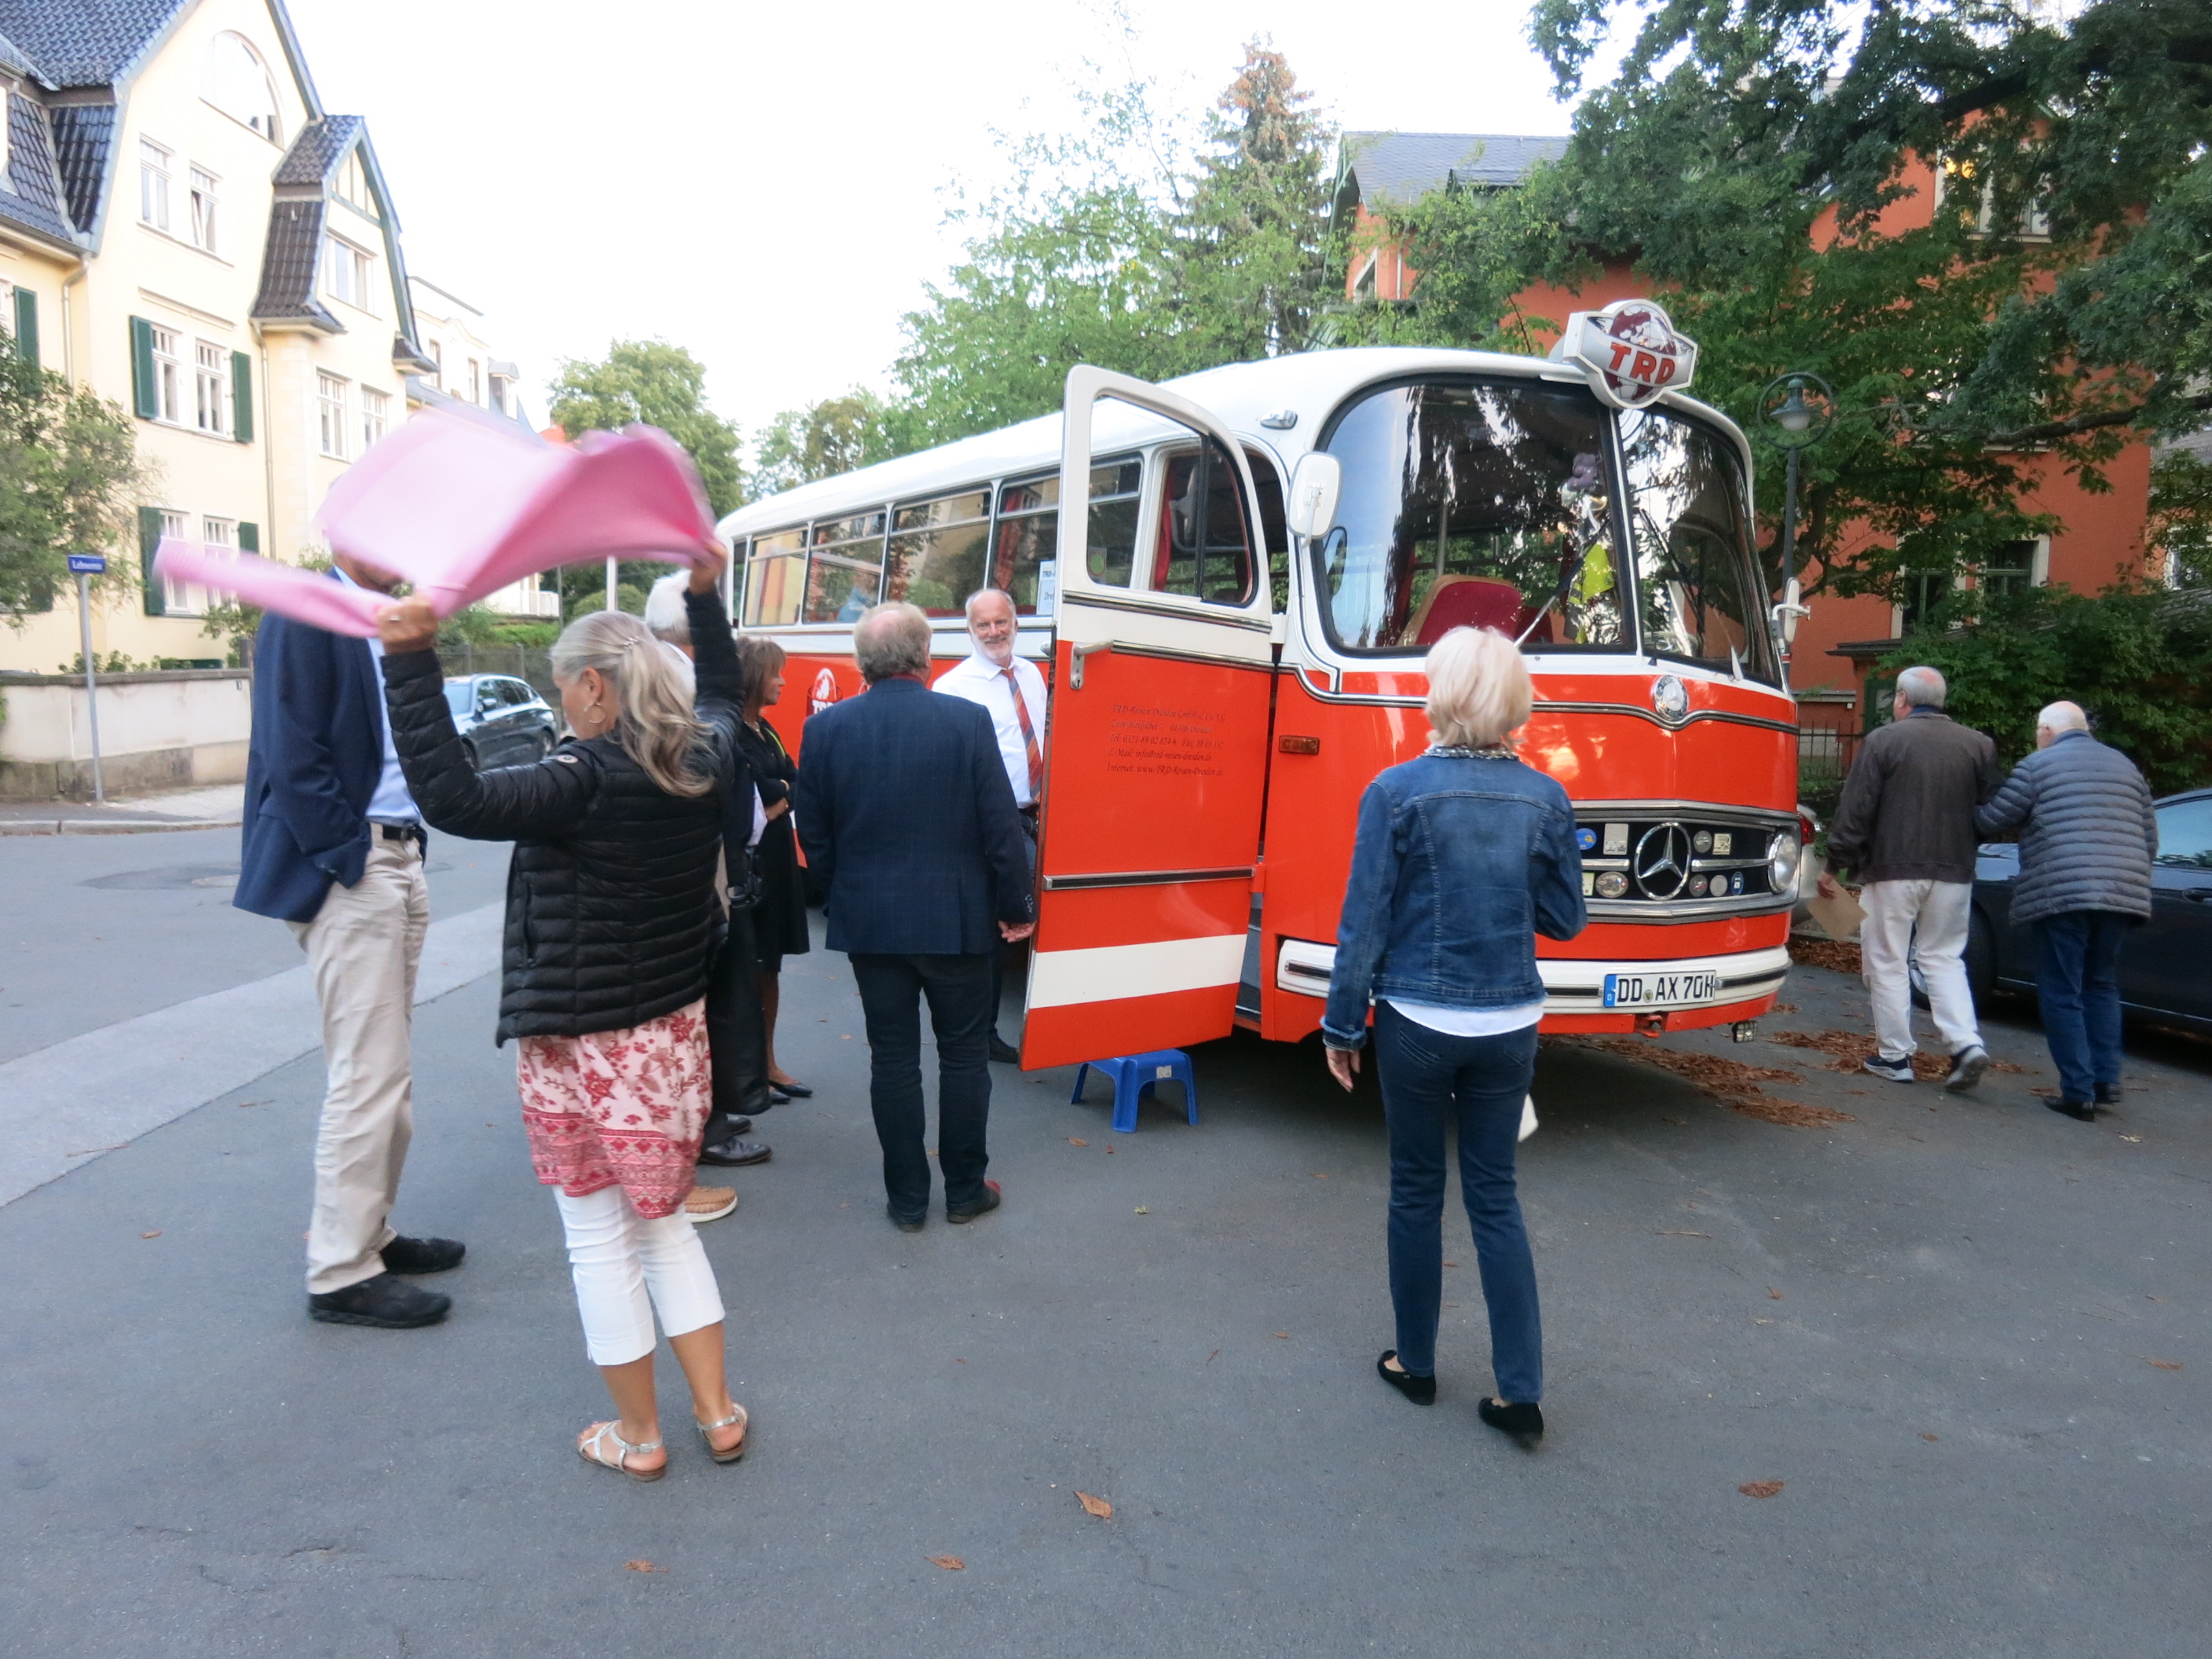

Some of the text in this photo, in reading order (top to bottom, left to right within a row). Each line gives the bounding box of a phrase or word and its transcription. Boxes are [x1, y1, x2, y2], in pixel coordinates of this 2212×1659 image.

[1609, 342, 1675, 385] TRD
[1112, 704, 1151, 716] TRD-Reisen
[1152, 707, 1177, 717] Dresden
[1617, 978, 1643, 1002] DD
[1655, 976, 1679, 1001] AX
